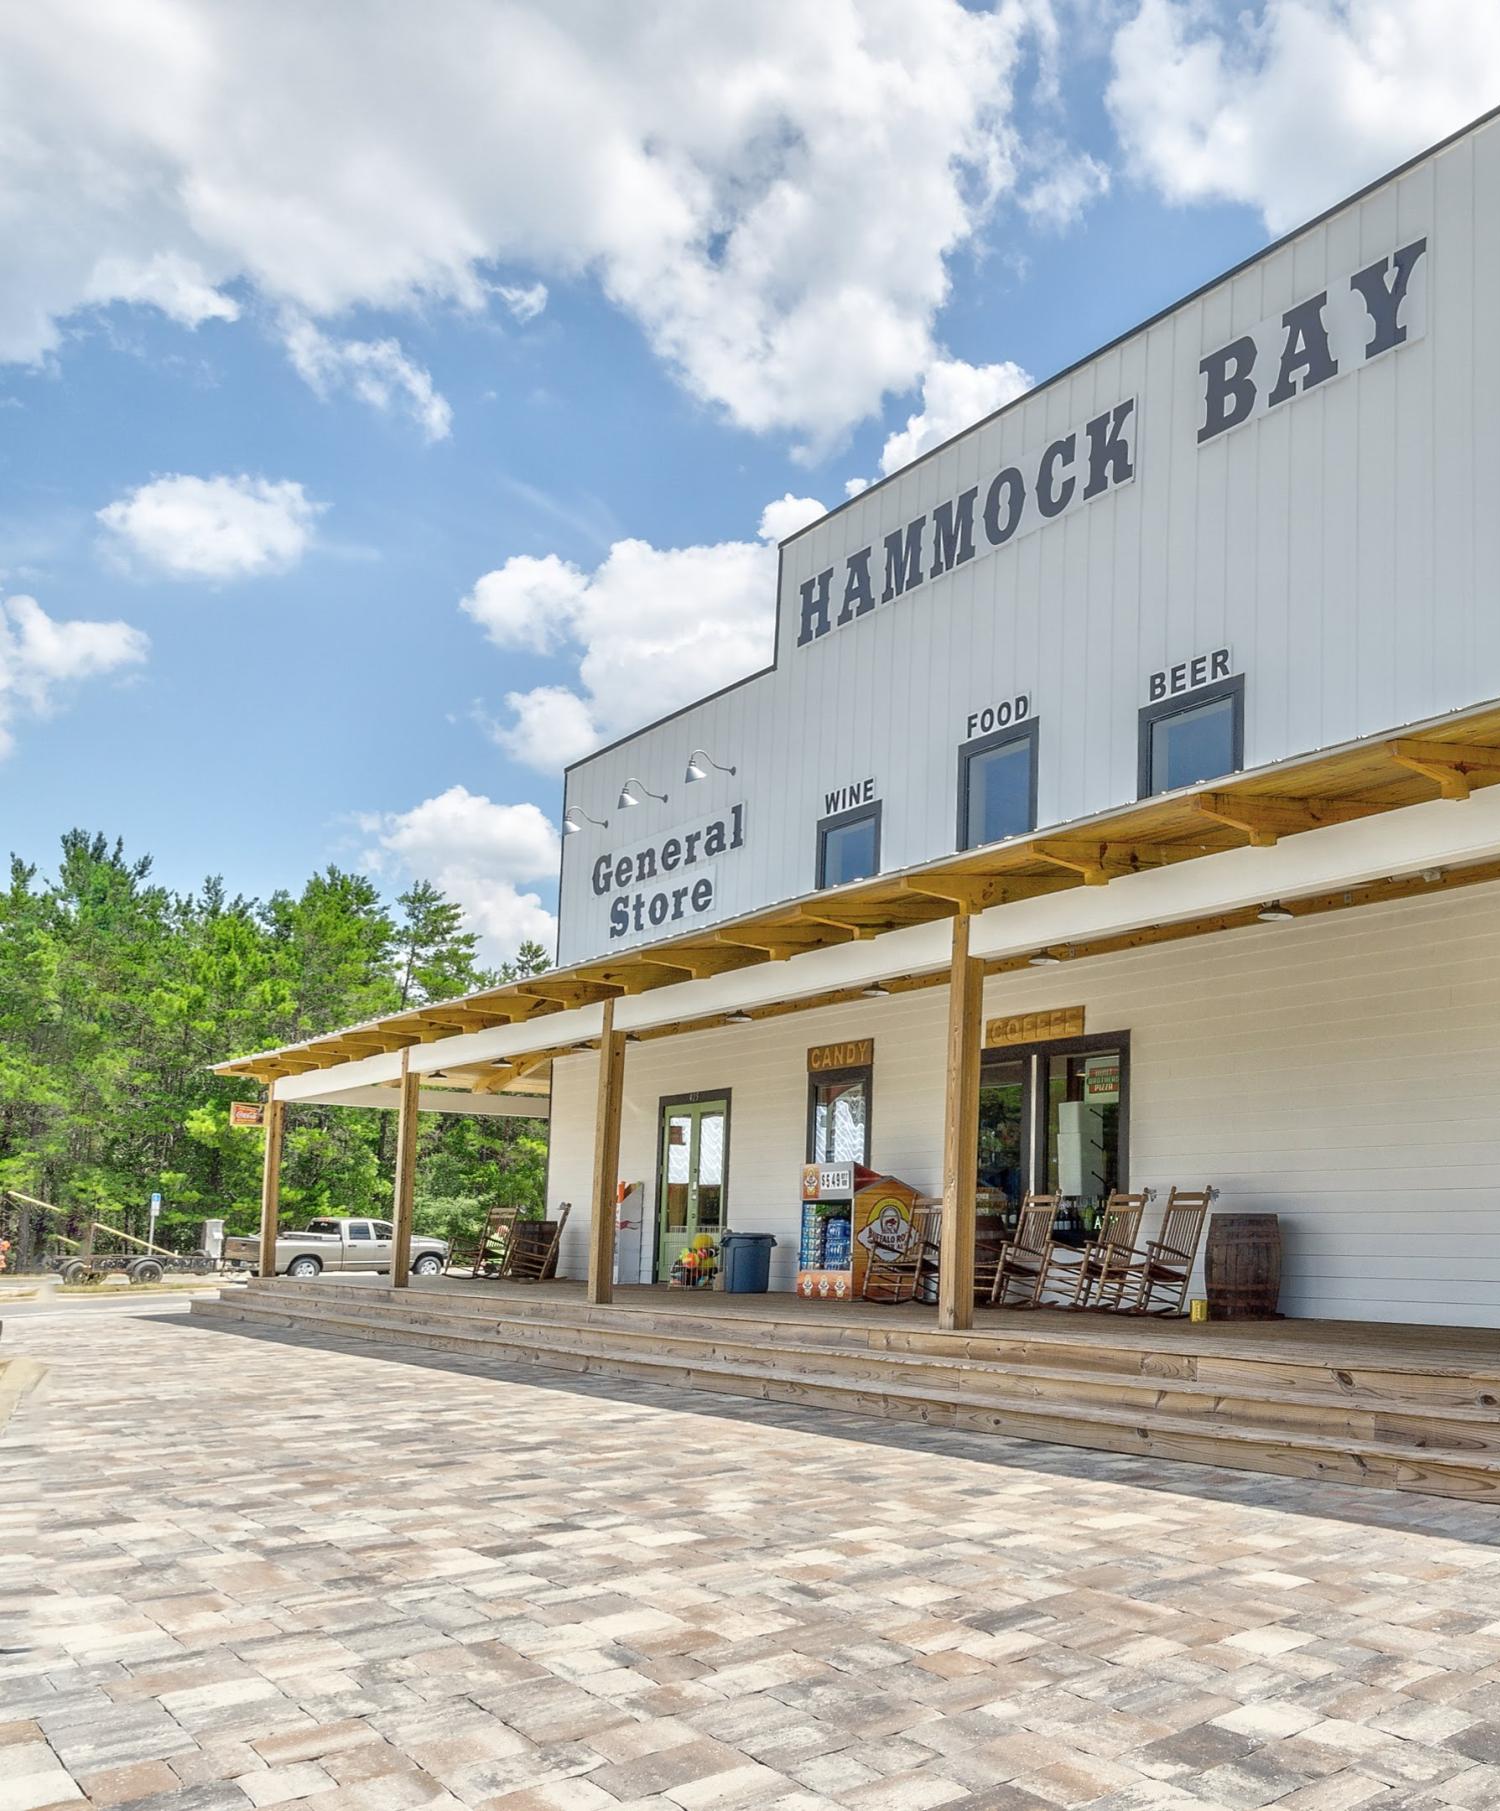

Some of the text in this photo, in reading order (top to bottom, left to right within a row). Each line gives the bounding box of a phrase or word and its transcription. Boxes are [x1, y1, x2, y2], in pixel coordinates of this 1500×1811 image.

[796, 237, 1427, 648] HAMMOCK BAY
[1149, 648, 1230, 701] BEER
[967, 695, 1029, 738] FOOD
[824, 778, 875, 815] WINE
[592, 804, 744, 896] General
[609, 878, 713, 939] Store
[811, 1040, 868, 1068] CANDY
